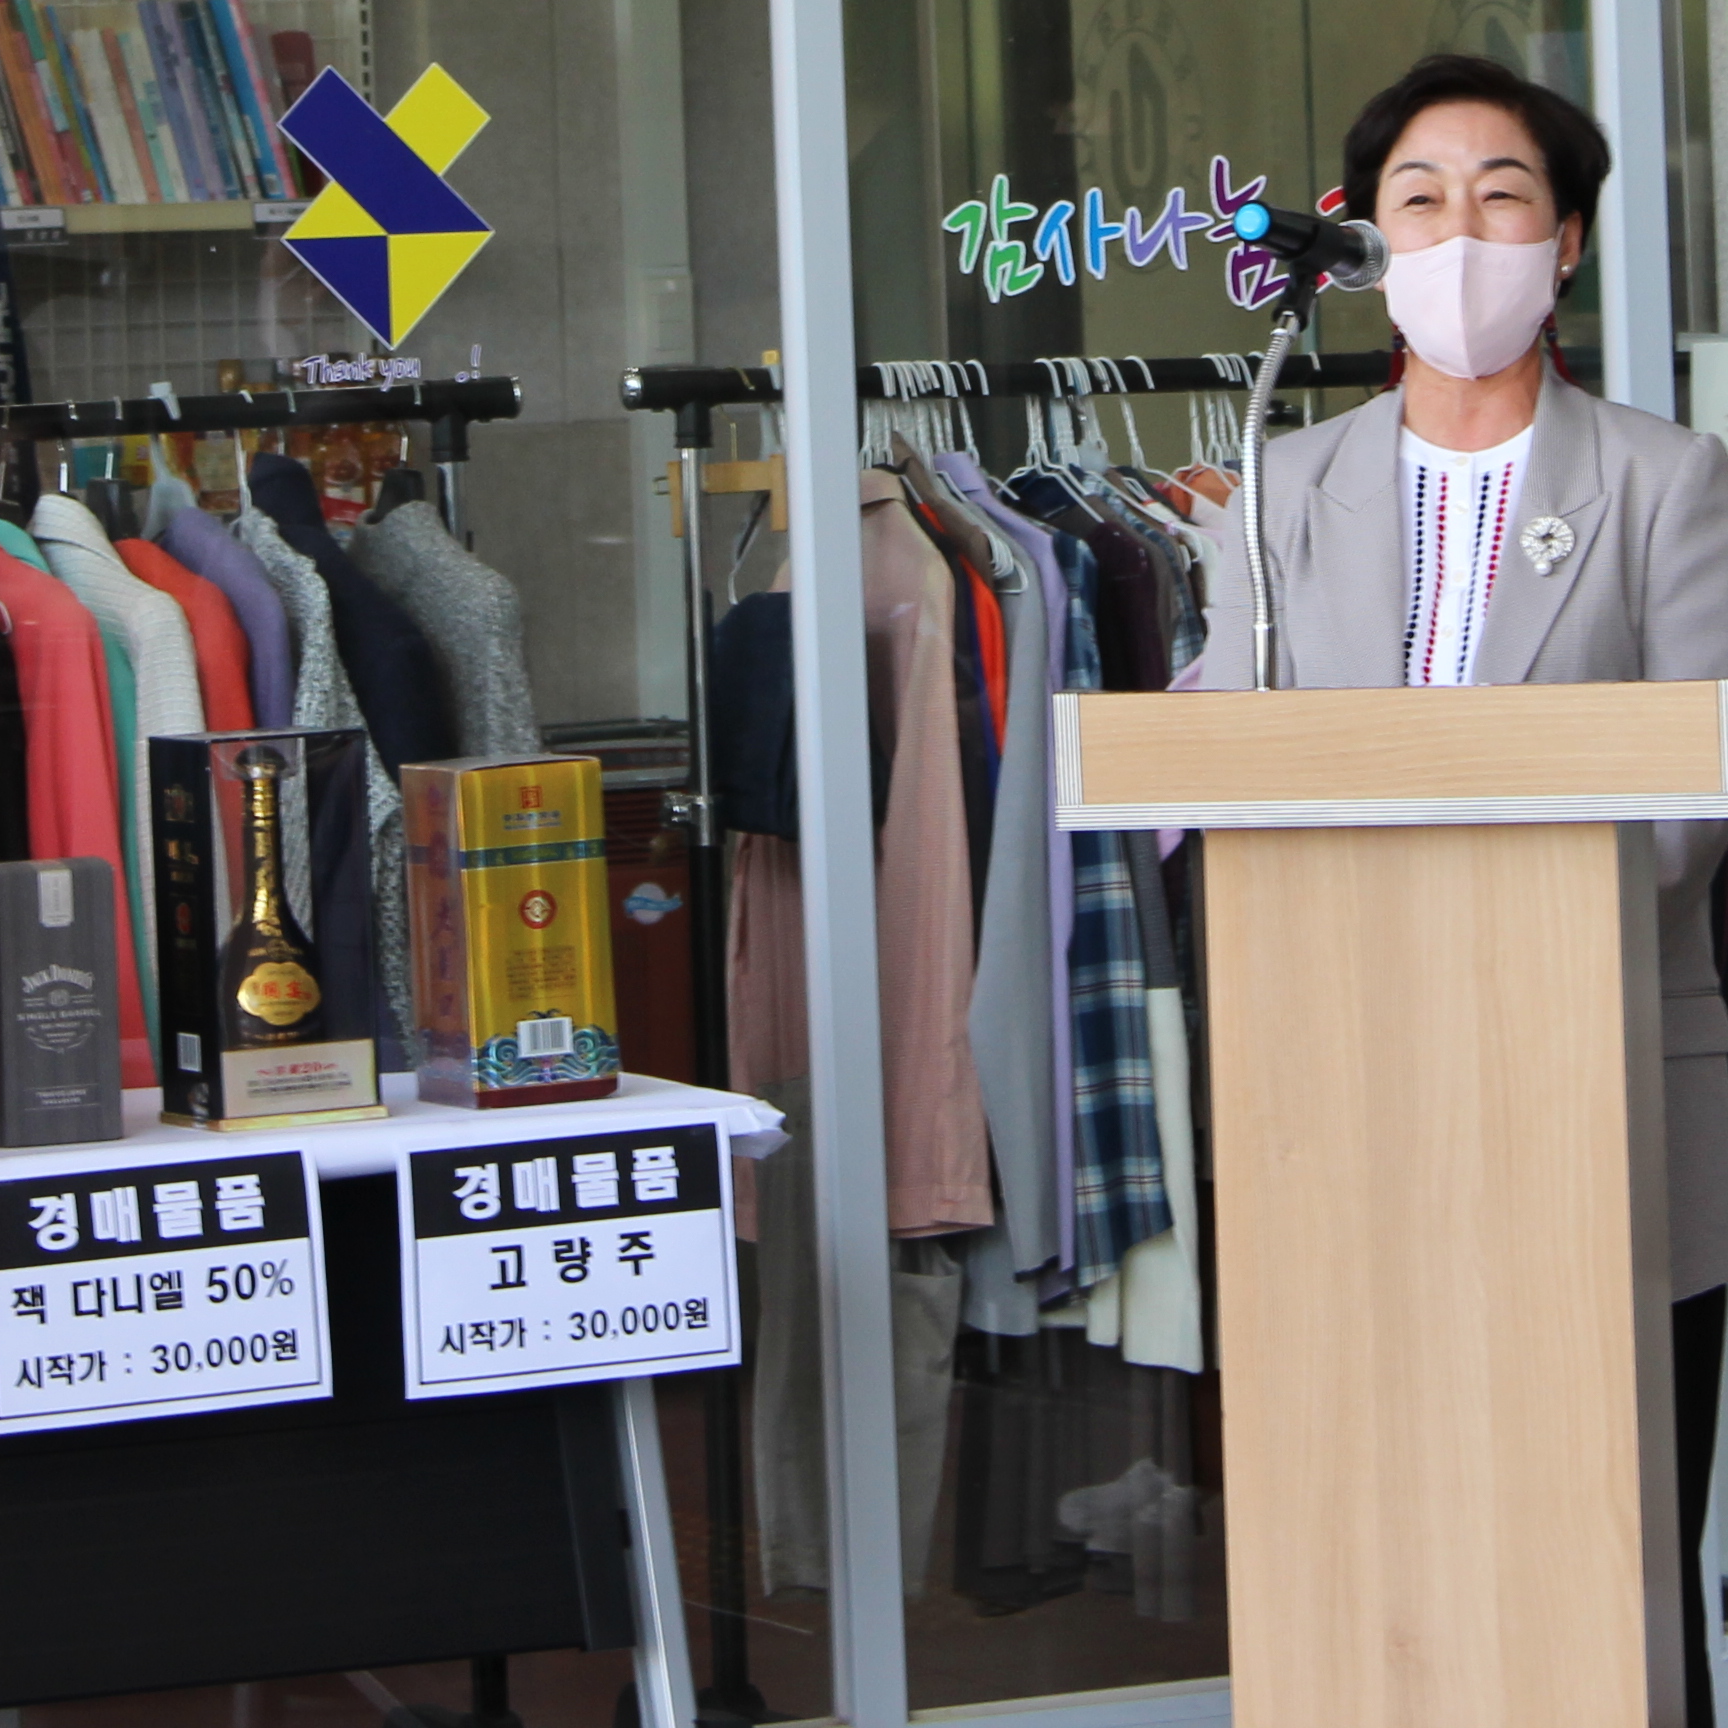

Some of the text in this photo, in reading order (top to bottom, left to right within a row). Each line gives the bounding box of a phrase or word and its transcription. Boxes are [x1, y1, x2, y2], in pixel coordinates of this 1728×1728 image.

[300, 352, 374, 385] Thank
[379, 357, 421, 392] you
[28, 1174, 266, 1251] 경매물품
[452, 1145, 680, 1220] 경매물품
[11, 1258, 295, 1324] 잭 다니엘 50%
[439, 1318, 527, 1355] 시작가
[569, 1297, 709, 1341] 30,000원
[15, 1351, 107, 1389] 시작가
[150, 1328, 299, 1374] 30,000원
